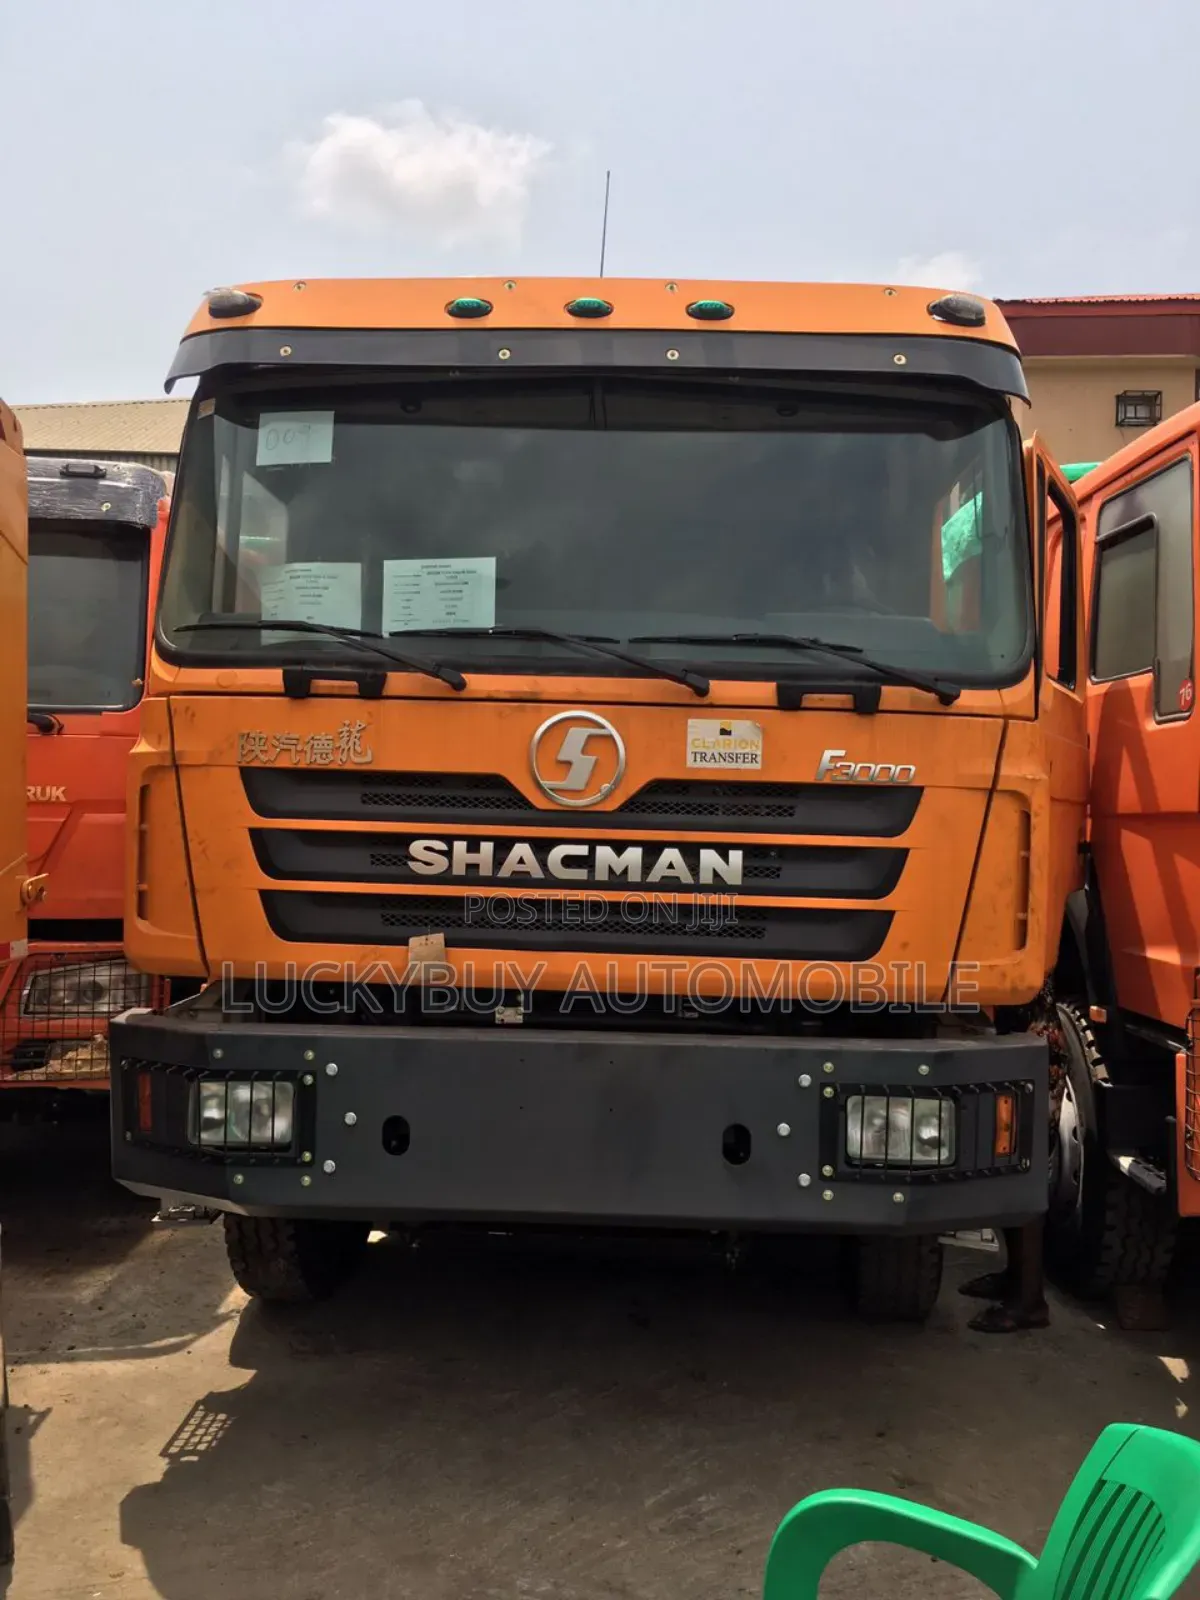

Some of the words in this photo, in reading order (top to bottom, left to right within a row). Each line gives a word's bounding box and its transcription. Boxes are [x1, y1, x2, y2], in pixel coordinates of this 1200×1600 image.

[690, 738, 760, 750] CLARION
[691, 751, 760, 765] TRANSFER
[815, 749, 917, 784] F3000
[408, 839, 743, 886] SHACMAN
